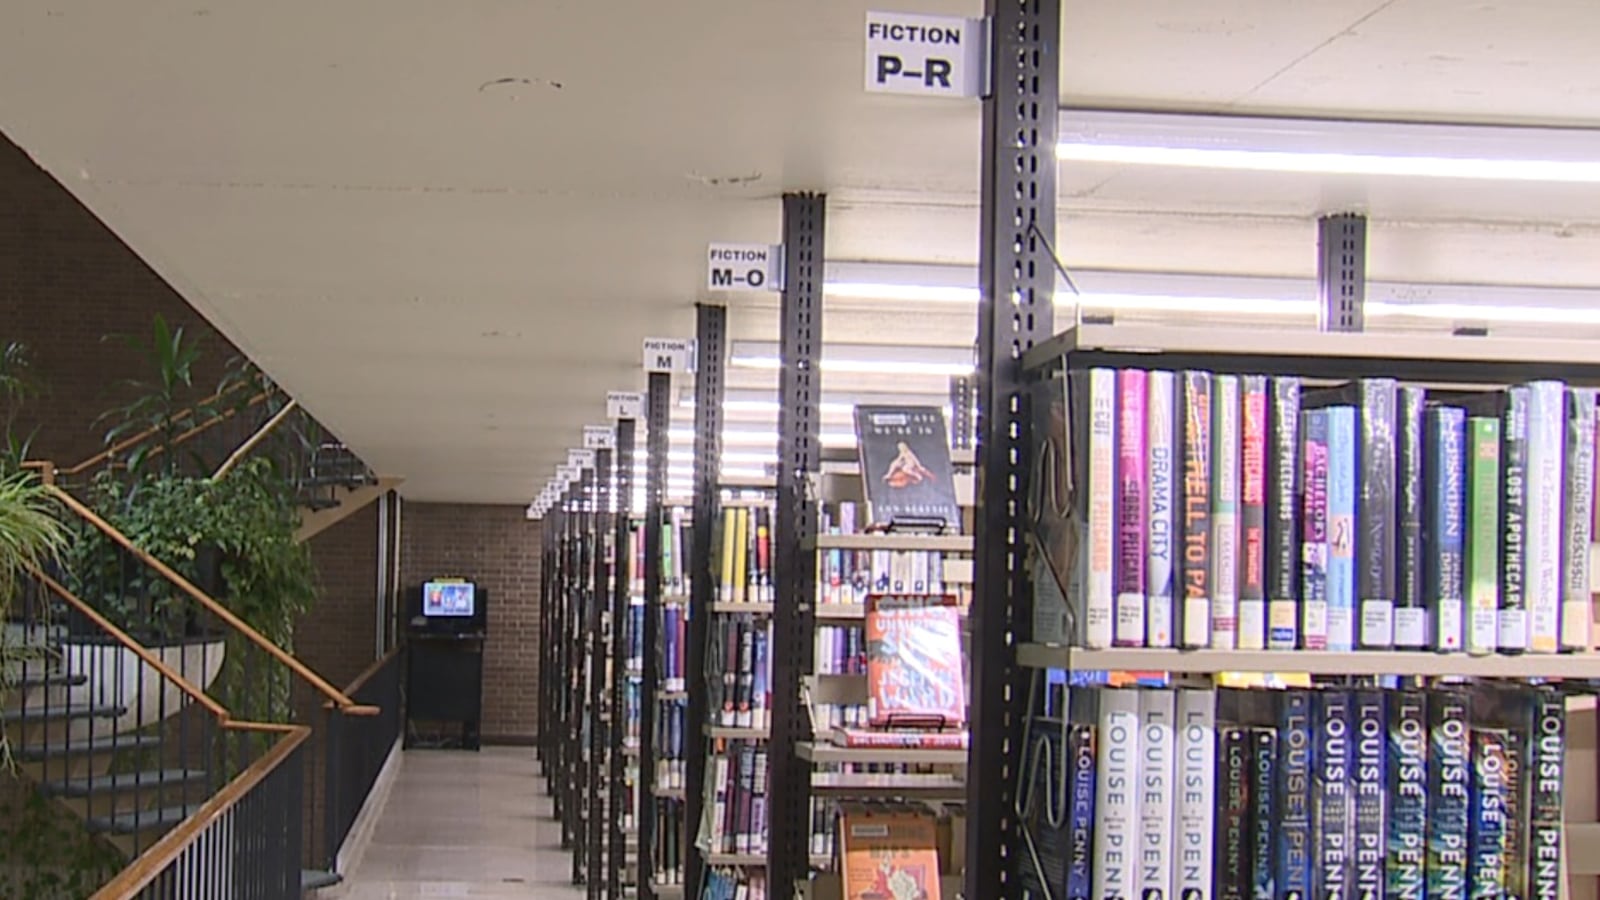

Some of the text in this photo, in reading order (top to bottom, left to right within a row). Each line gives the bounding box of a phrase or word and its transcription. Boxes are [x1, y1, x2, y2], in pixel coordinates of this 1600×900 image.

[869, 23, 960, 44] FICTION
[710, 250, 767, 261] FICTION
[644, 341, 685, 350] FICTION
[656, 355, 672, 368] M
[620, 405, 628, 415] L
[1149, 448, 1168, 561] DRAMA CITY
[1506, 466, 1523, 506] LOST
[1185, 531, 1206, 562] TO
[1107, 712, 1127, 805] LOUISE
[1145, 711, 1164, 804] LOUISE
[1185, 711, 1204, 804] LOUISE
[1287, 715, 1305, 810] LOUISE
[1325, 705, 1345, 796] LOUISE
[1360, 705, 1379, 796] LOUISE
[1400, 705, 1420, 797] LOUISE
[1442, 706, 1463, 797] LOUISE
[1481, 744, 1501, 823] LOUISE
[1542, 702, 1561, 793] LOUISE
[1073, 746, 1091, 878] LOUISE PENNY
[1227, 746, 1241, 876] LOUISE PENNY
[1255, 750, 1270, 880] LOUISE PENNY
